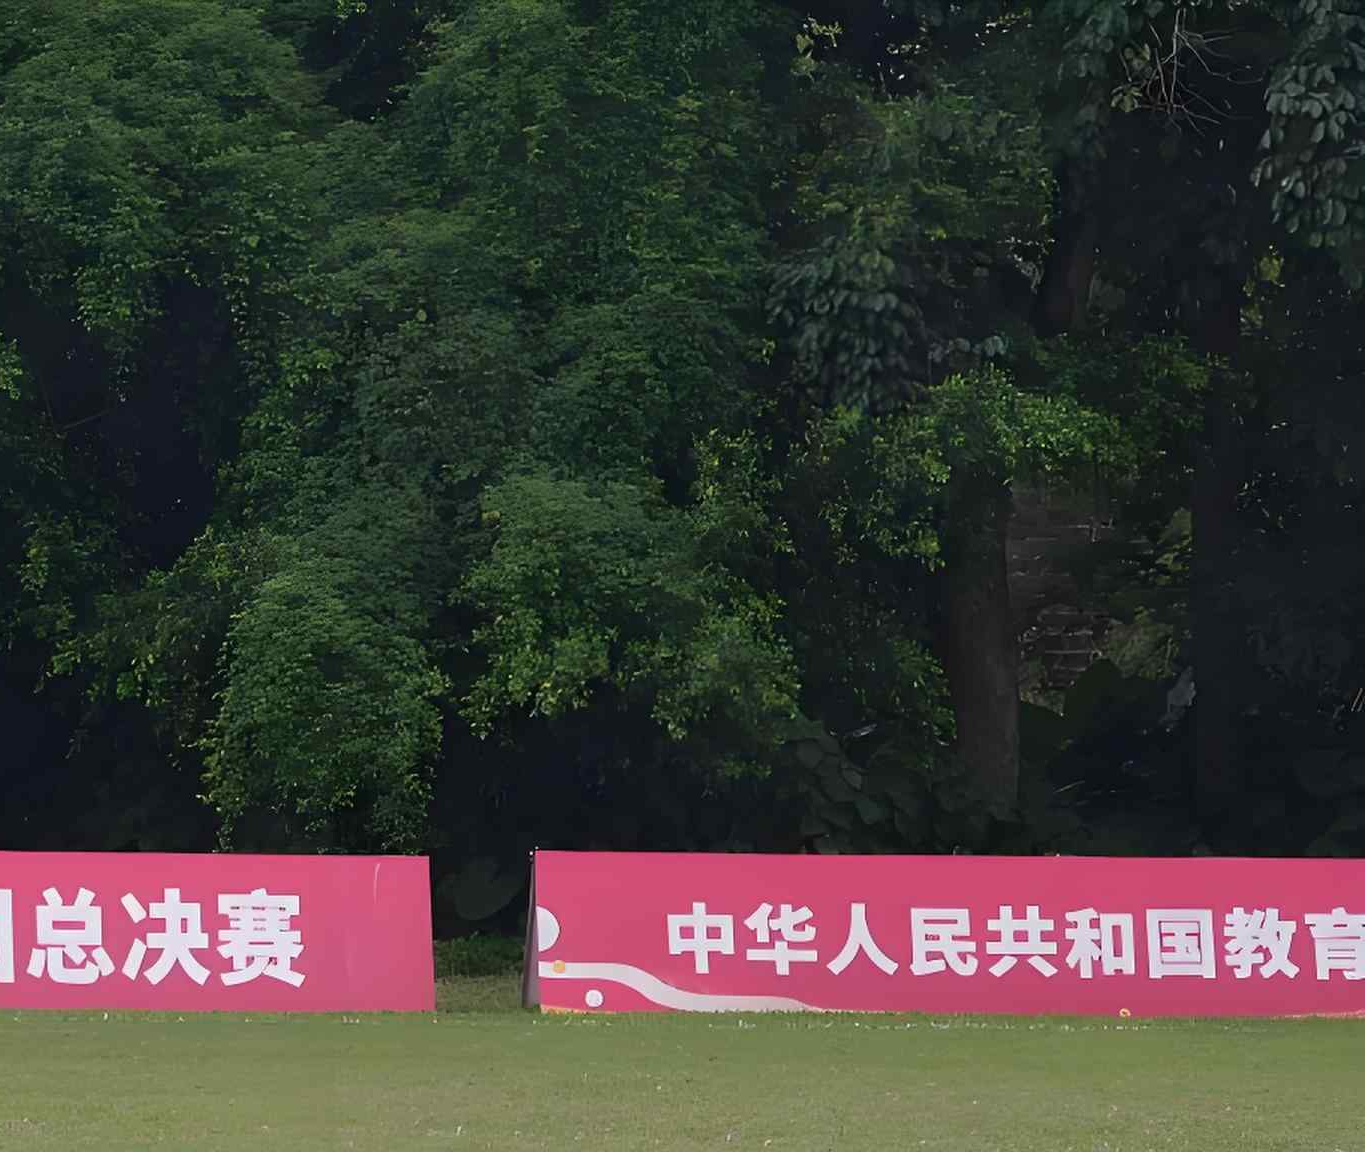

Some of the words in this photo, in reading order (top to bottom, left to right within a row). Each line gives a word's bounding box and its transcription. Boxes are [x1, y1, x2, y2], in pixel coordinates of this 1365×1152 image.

[667, 902, 1365, 980] 中华人民共和国教育
